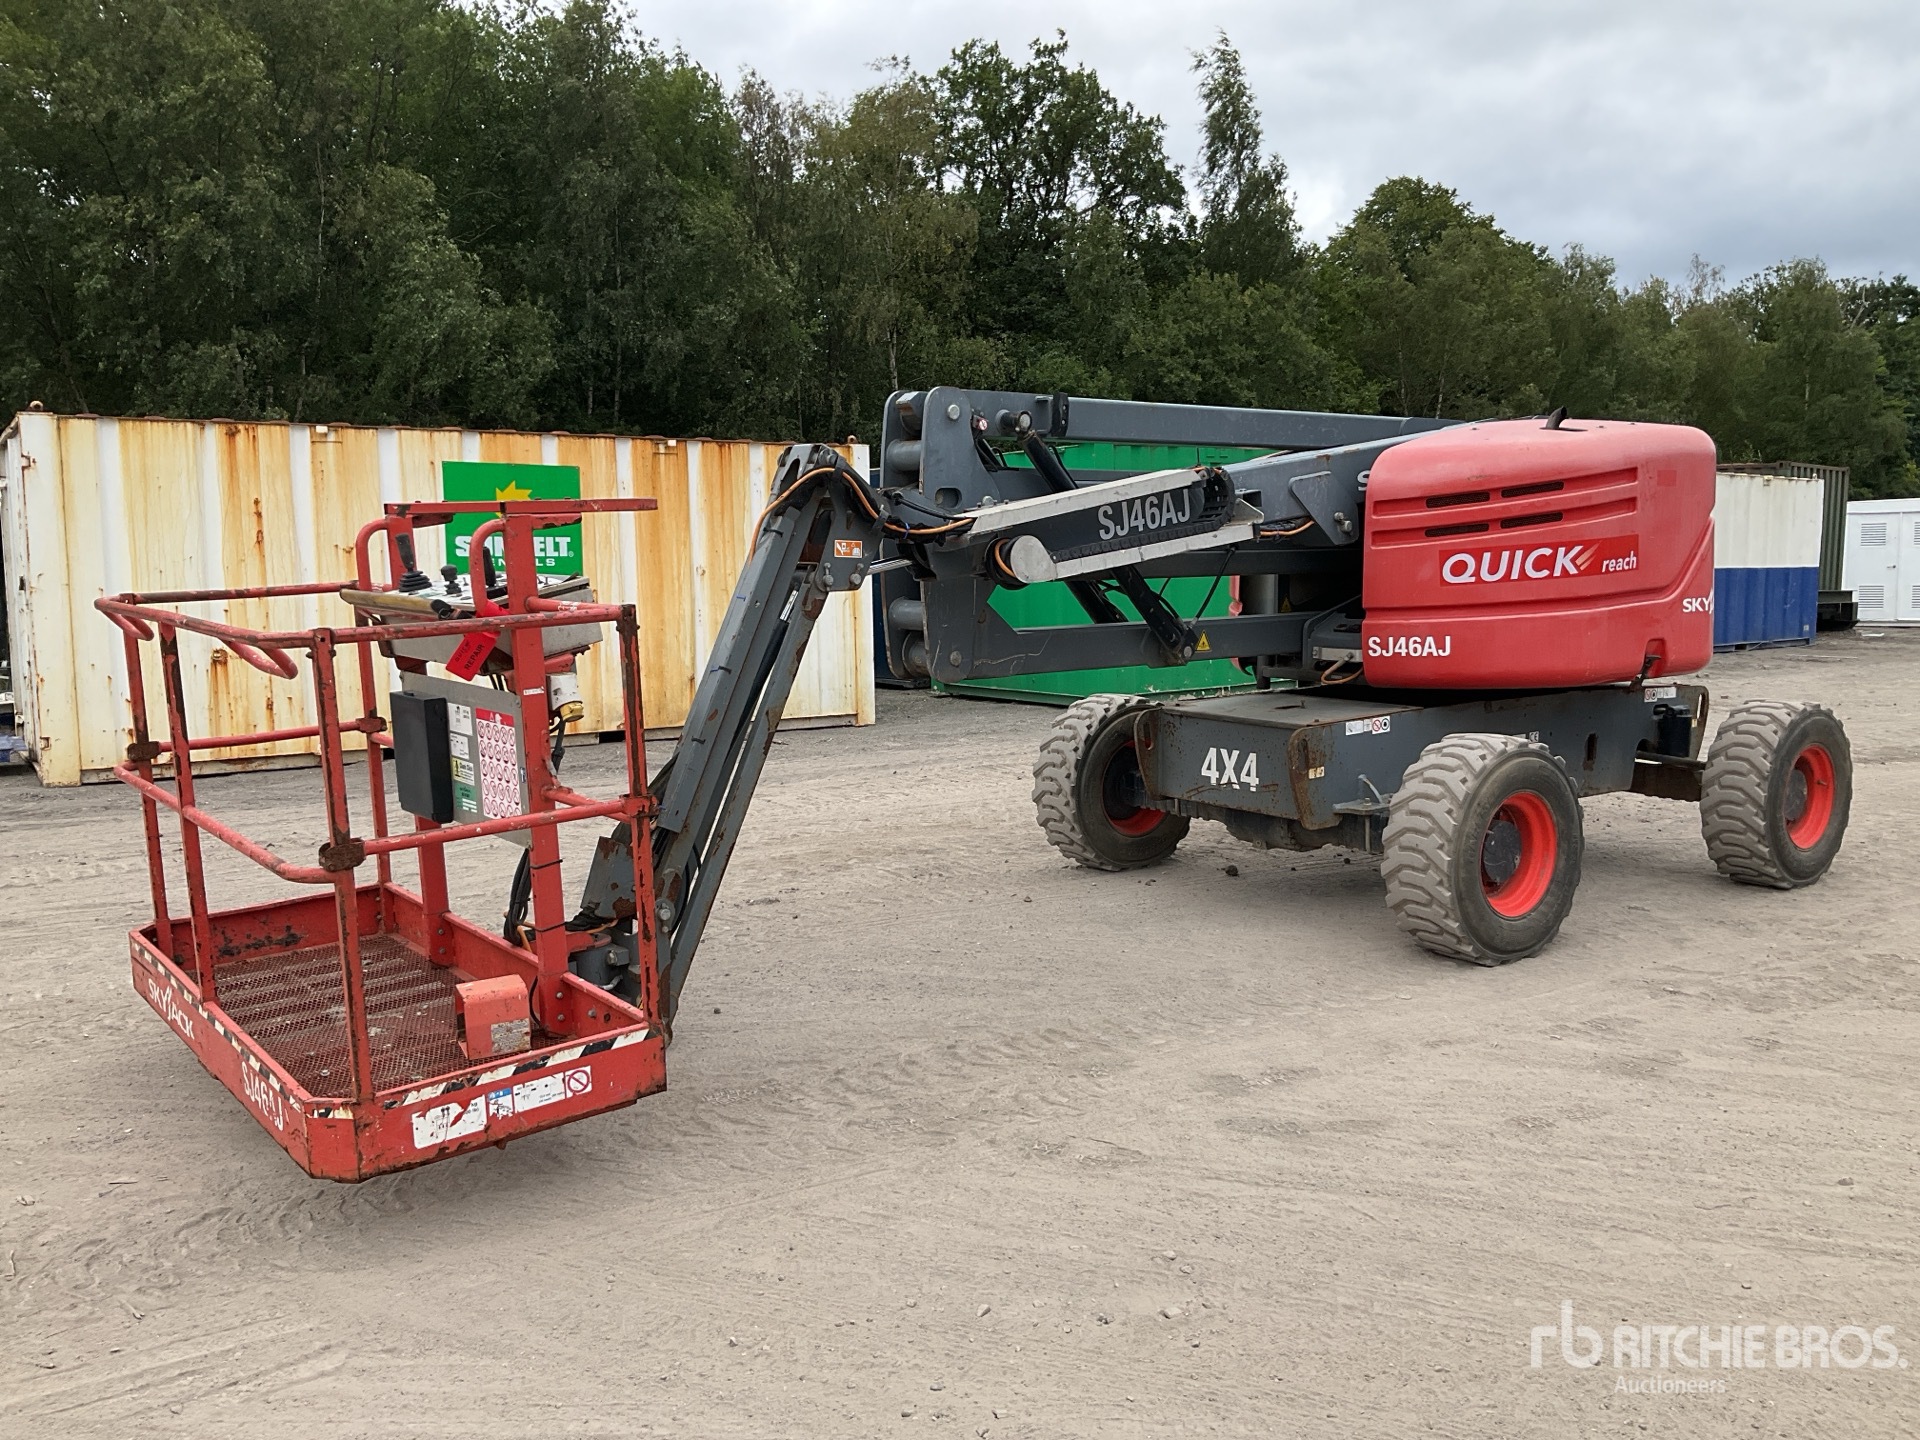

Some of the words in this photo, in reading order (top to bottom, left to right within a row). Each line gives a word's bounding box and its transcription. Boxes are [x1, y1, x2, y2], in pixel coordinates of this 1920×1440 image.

[1097, 489, 1190, 540] SJ46AJ
[1442, 546, 1583, 583] QUICK
[1602, 551, 1636, 572] reach
[464, 644, 485, 670] REPAIR
[1368, 635, 1451, 657] SJ46AJ
[1201, 747, 1259, 792] 4X4
[149, 978, 195, 1040] SKYJACK
